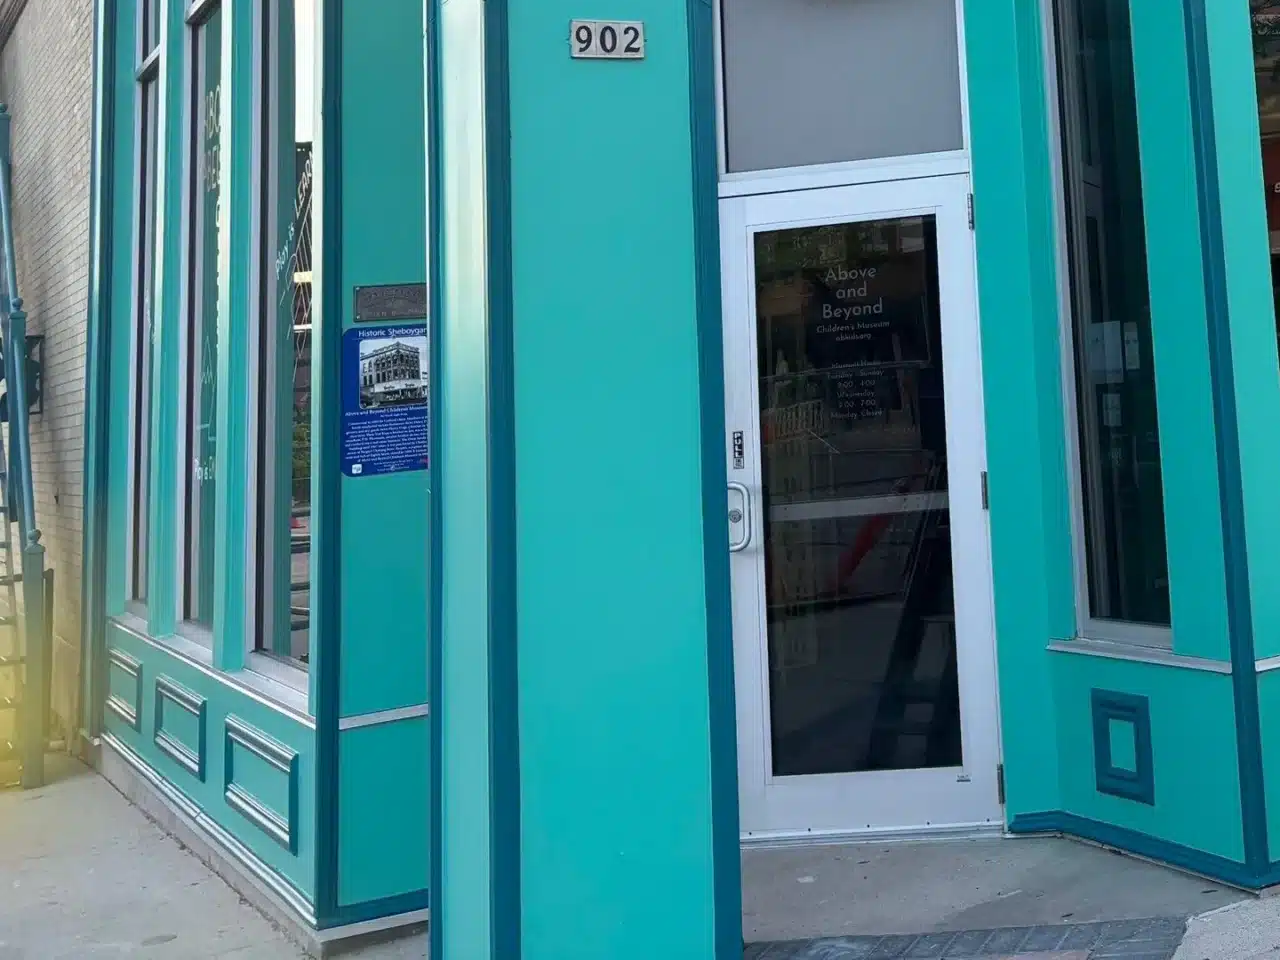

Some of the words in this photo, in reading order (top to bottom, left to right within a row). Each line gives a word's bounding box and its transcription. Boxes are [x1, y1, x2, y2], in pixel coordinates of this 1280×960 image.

[575, 25, 641, 53] 902
[825, 265, 877, 283] Above
[835, 283, 867, 300] and
[822, 297, 883, 321] Beyond
[358, 329, 386, 337] Historic
